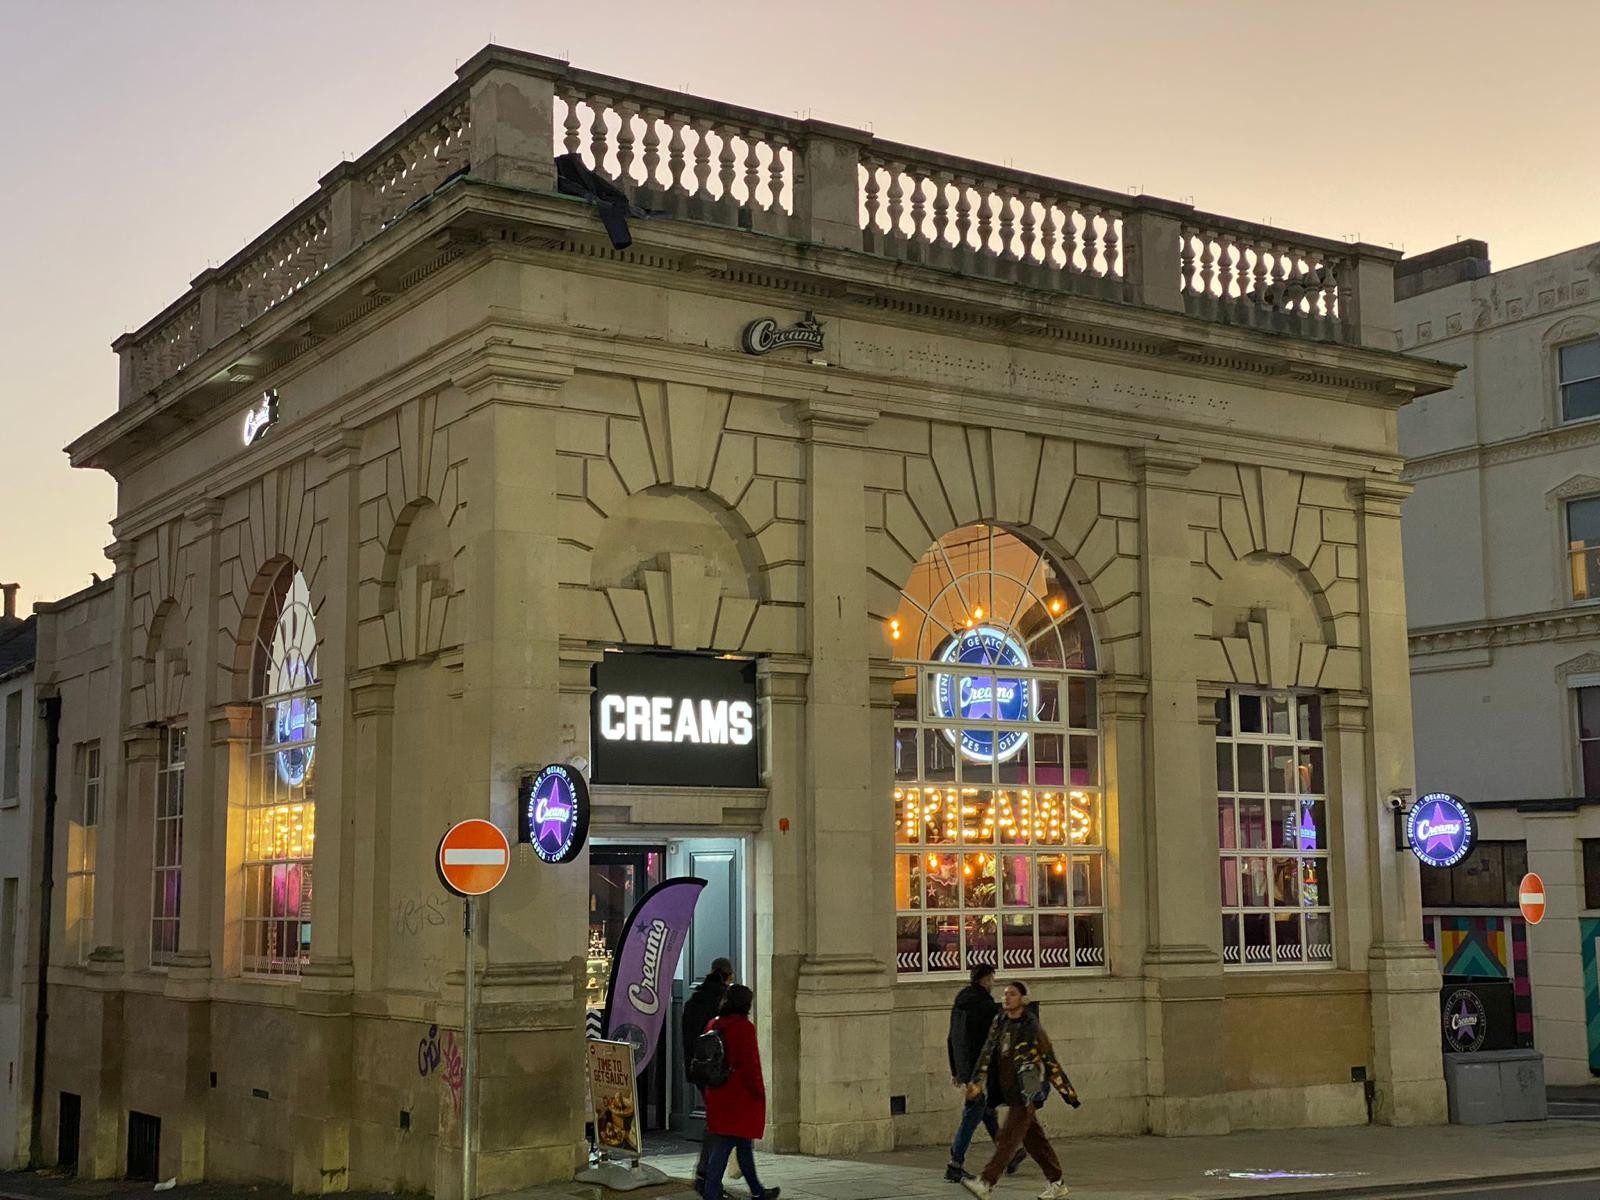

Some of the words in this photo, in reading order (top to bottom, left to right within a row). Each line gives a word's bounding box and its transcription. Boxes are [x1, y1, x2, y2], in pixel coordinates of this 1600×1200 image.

[601, 694, 753, 746] CREAMS
[1424, 793, 1451, 802] GELATO
[1417, 819, 1461, 840] Creams
[628, 919, 667, 1015] Creams
[613, 1060, 622, 1072] TO
